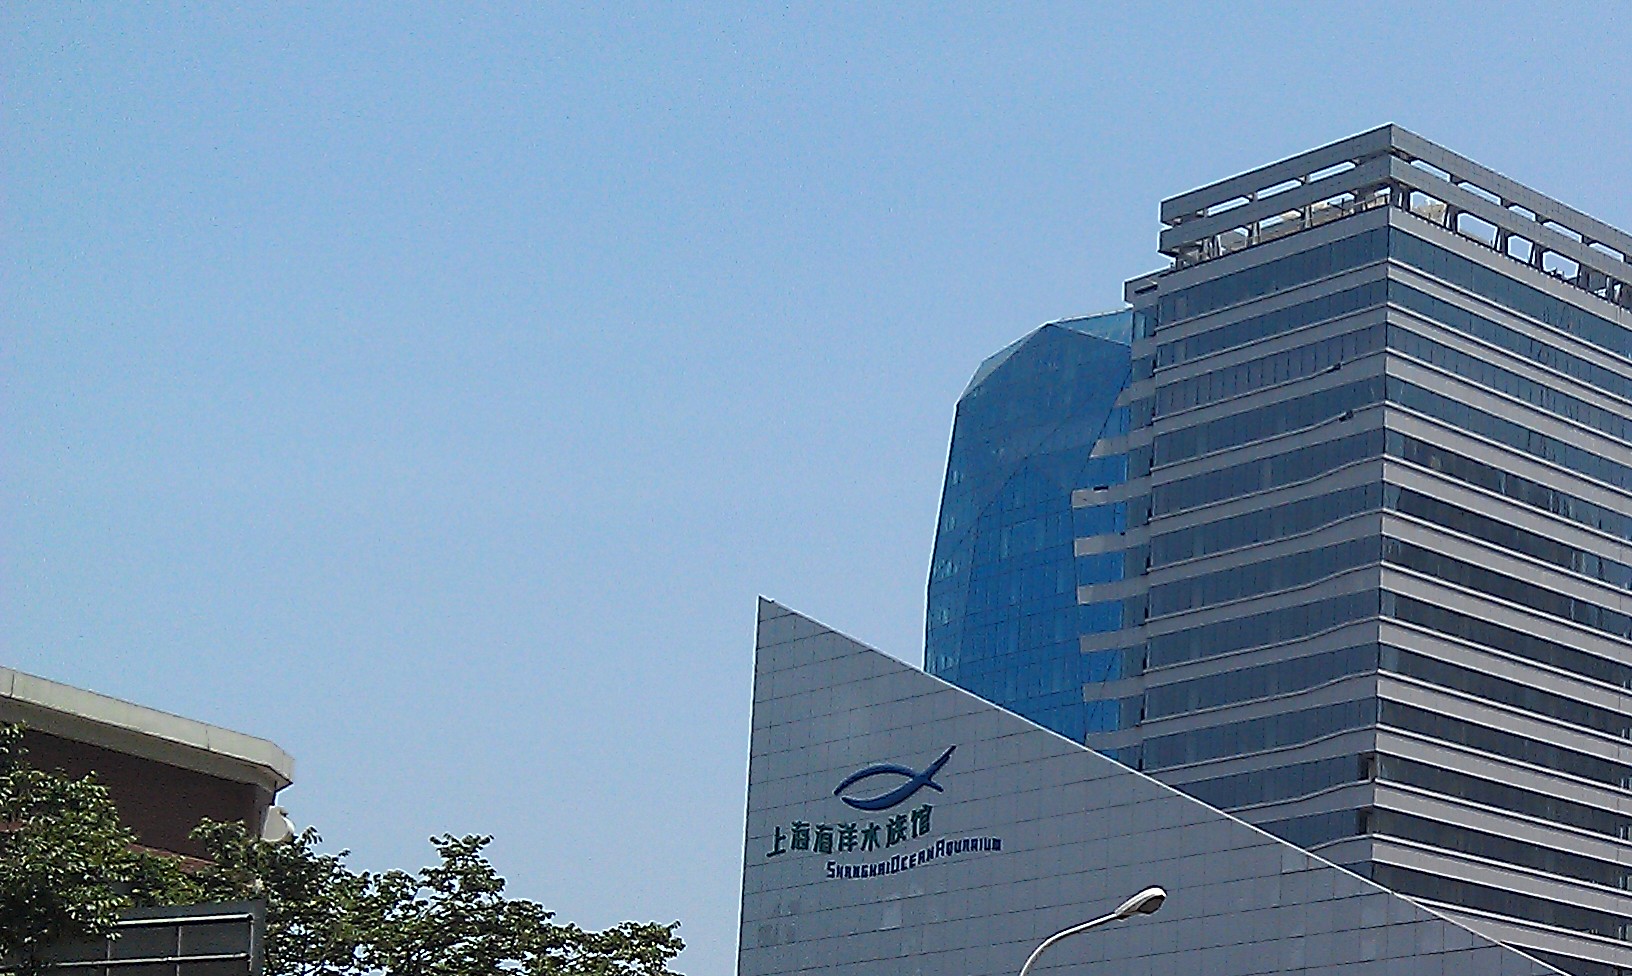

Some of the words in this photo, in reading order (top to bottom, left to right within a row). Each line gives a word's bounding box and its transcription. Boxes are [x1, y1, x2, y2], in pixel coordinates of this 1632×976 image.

[765, 803, 934, 858] 上海海洋水族馆
